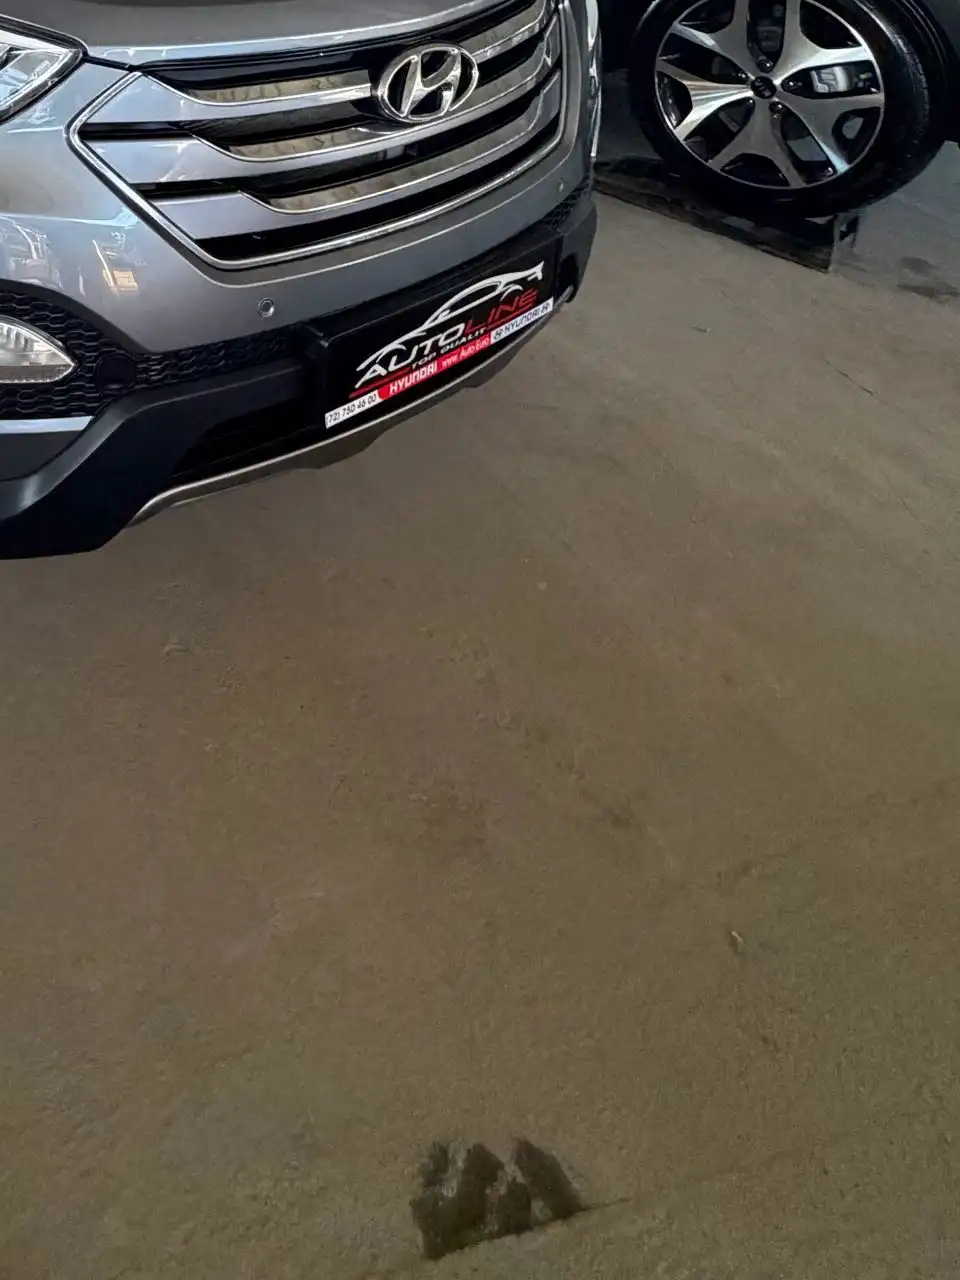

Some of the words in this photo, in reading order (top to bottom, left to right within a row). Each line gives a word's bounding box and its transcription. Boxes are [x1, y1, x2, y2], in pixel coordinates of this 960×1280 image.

[389, 360, 438, 395] HYUNDAI
[504, 307, 540, 333] HYUNDAI
[411, 351, 437, 369] TOP
